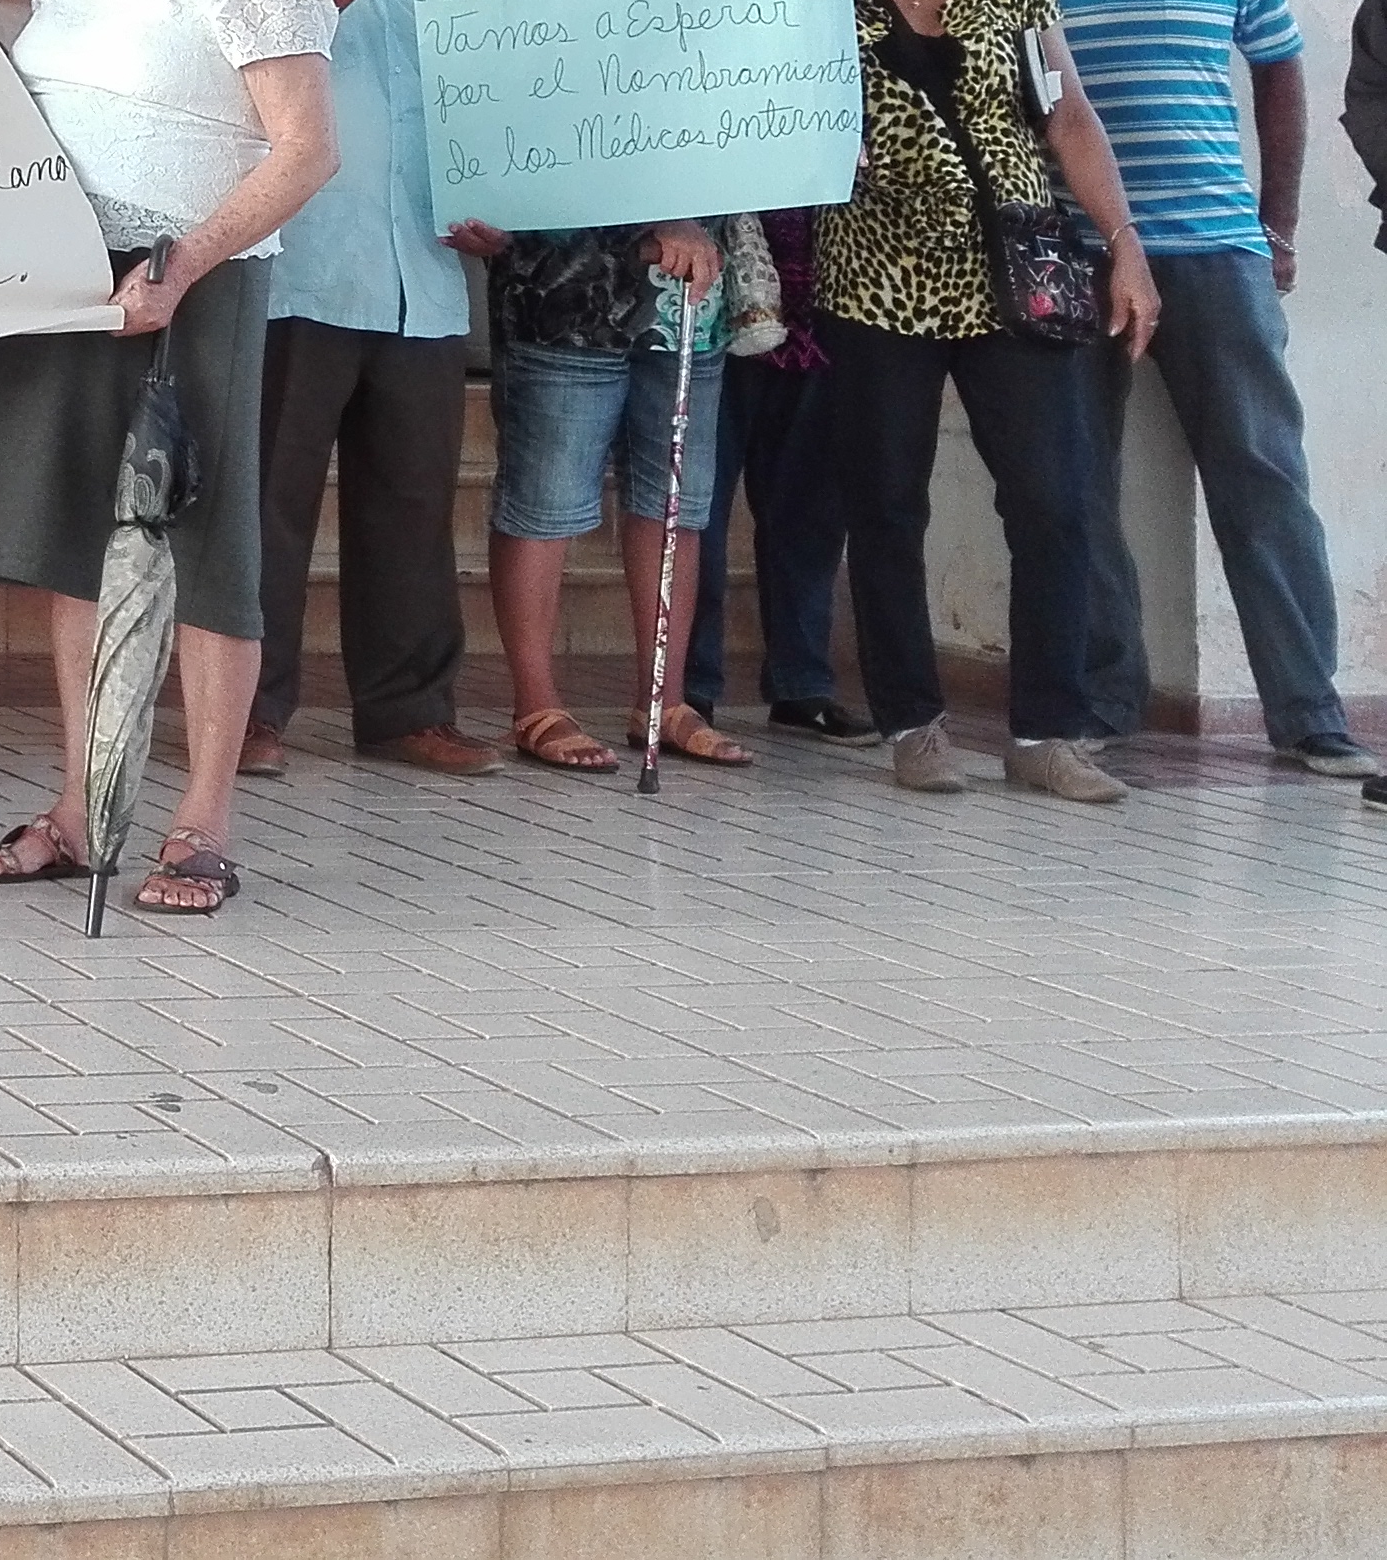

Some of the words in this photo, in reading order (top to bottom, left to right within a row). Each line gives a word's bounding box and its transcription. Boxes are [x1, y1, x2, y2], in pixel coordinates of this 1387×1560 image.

[424, 10, 579, 57] Vamos
[433, 73, 501, 124] por
[528, 57, 580, 100] el
[597, 48, 861, 96] Nombramiento
[445, 139, 487, 186] de
[500, 126, 573, 179] los
[572, 112, 715, 161] Médicos
